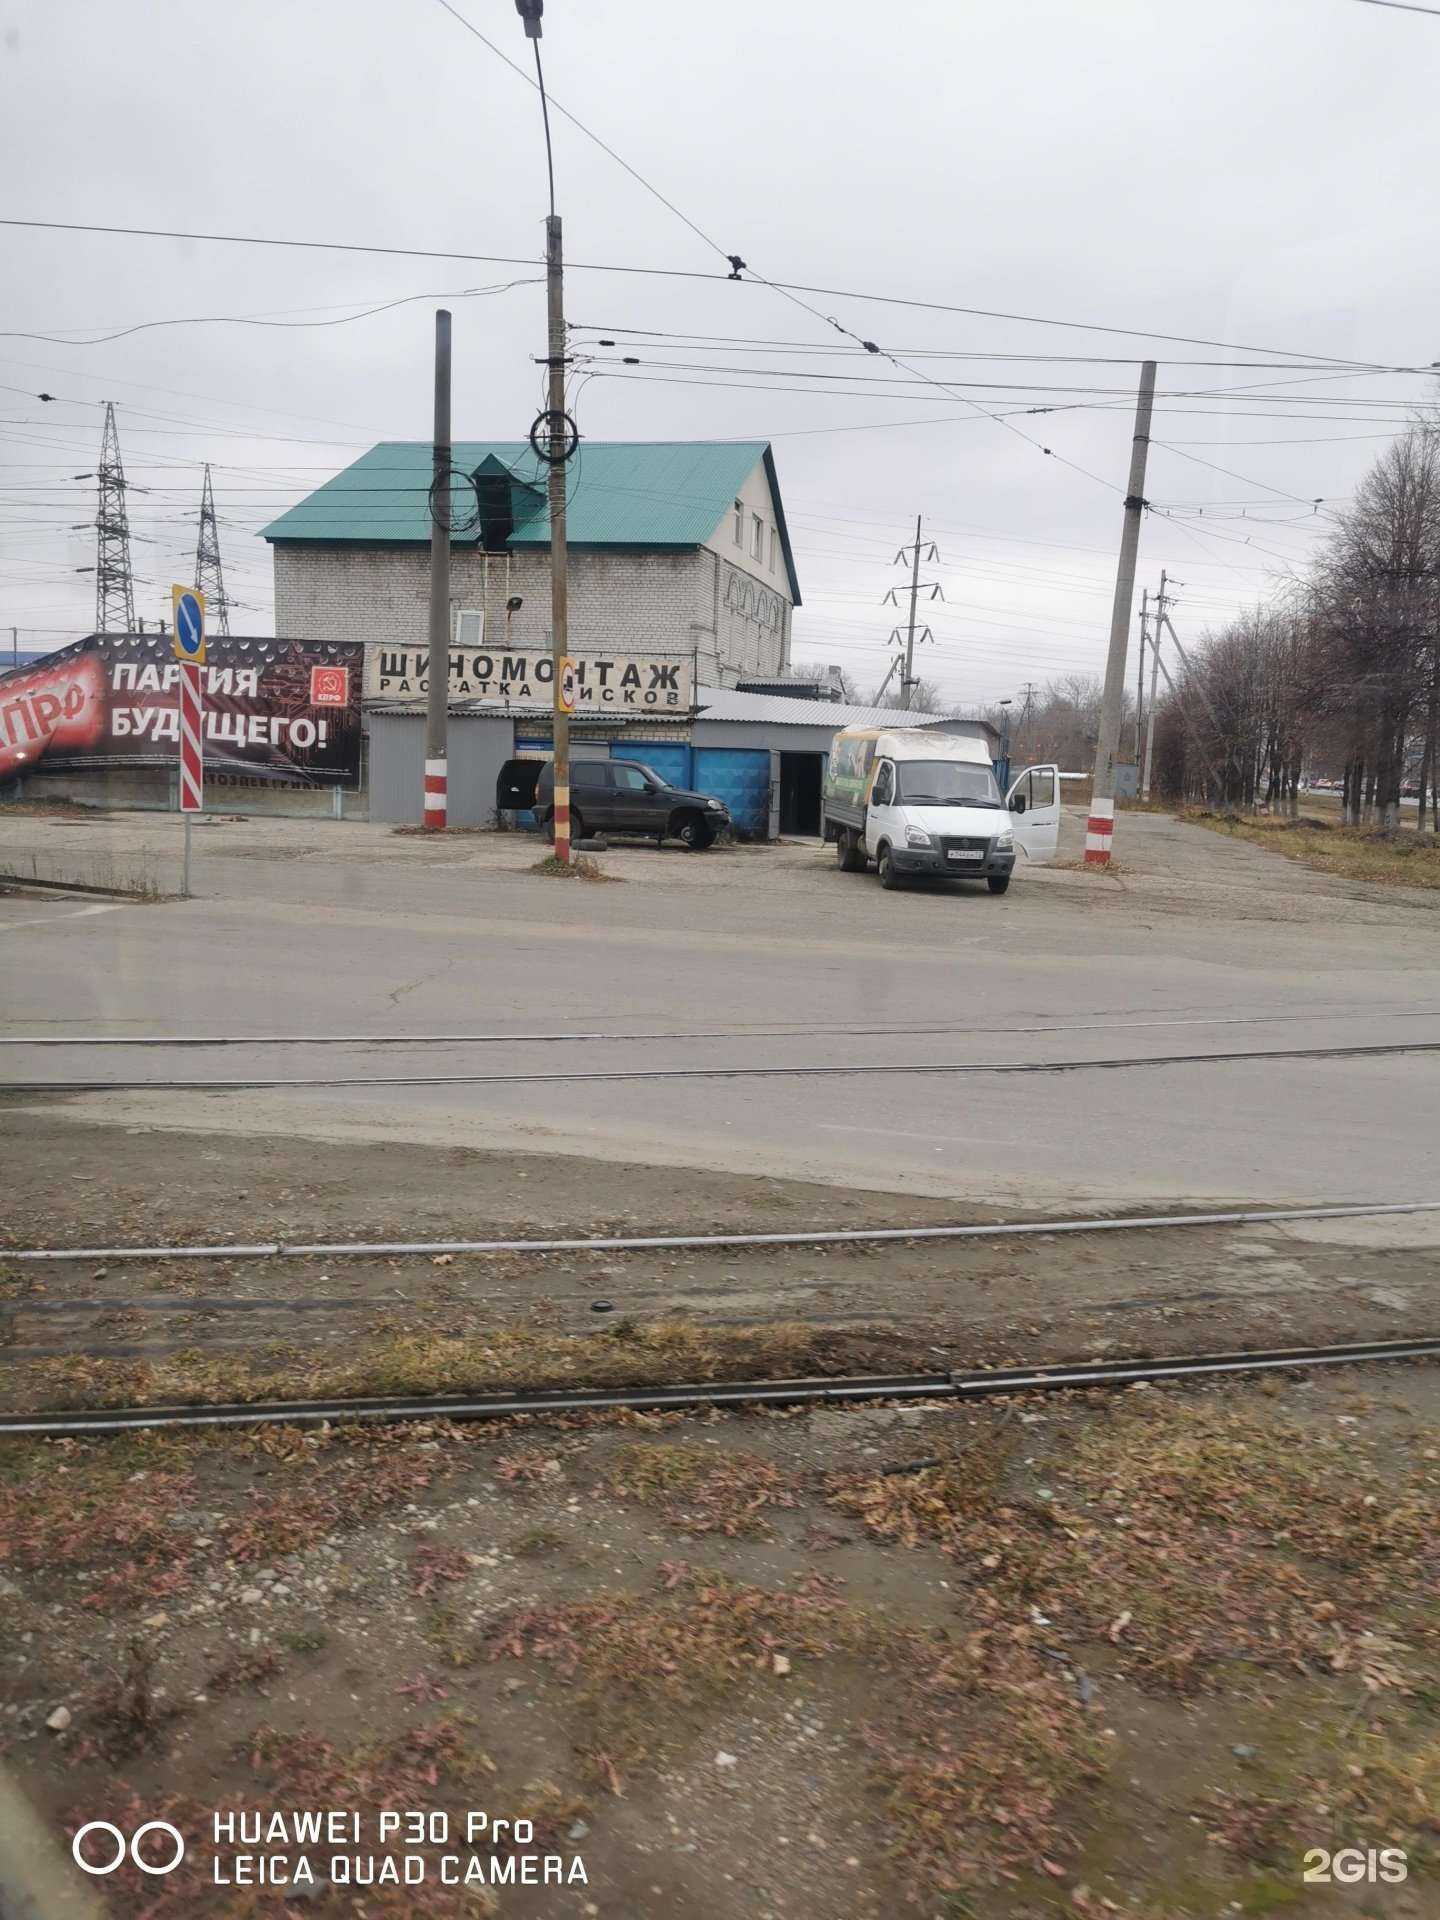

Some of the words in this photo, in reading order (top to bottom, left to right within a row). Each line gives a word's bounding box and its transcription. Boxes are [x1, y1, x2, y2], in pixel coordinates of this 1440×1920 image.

[380, 652, 680, 690] ШИНОМОНТАЖ
[380, 679, 531, 697] РАСАТКА
[580, 687, 679, 705] ИСКОВ
[0, 684, 85, 748] ПРФ
[112, 707, 327, 749] БУДЩЕГО!
